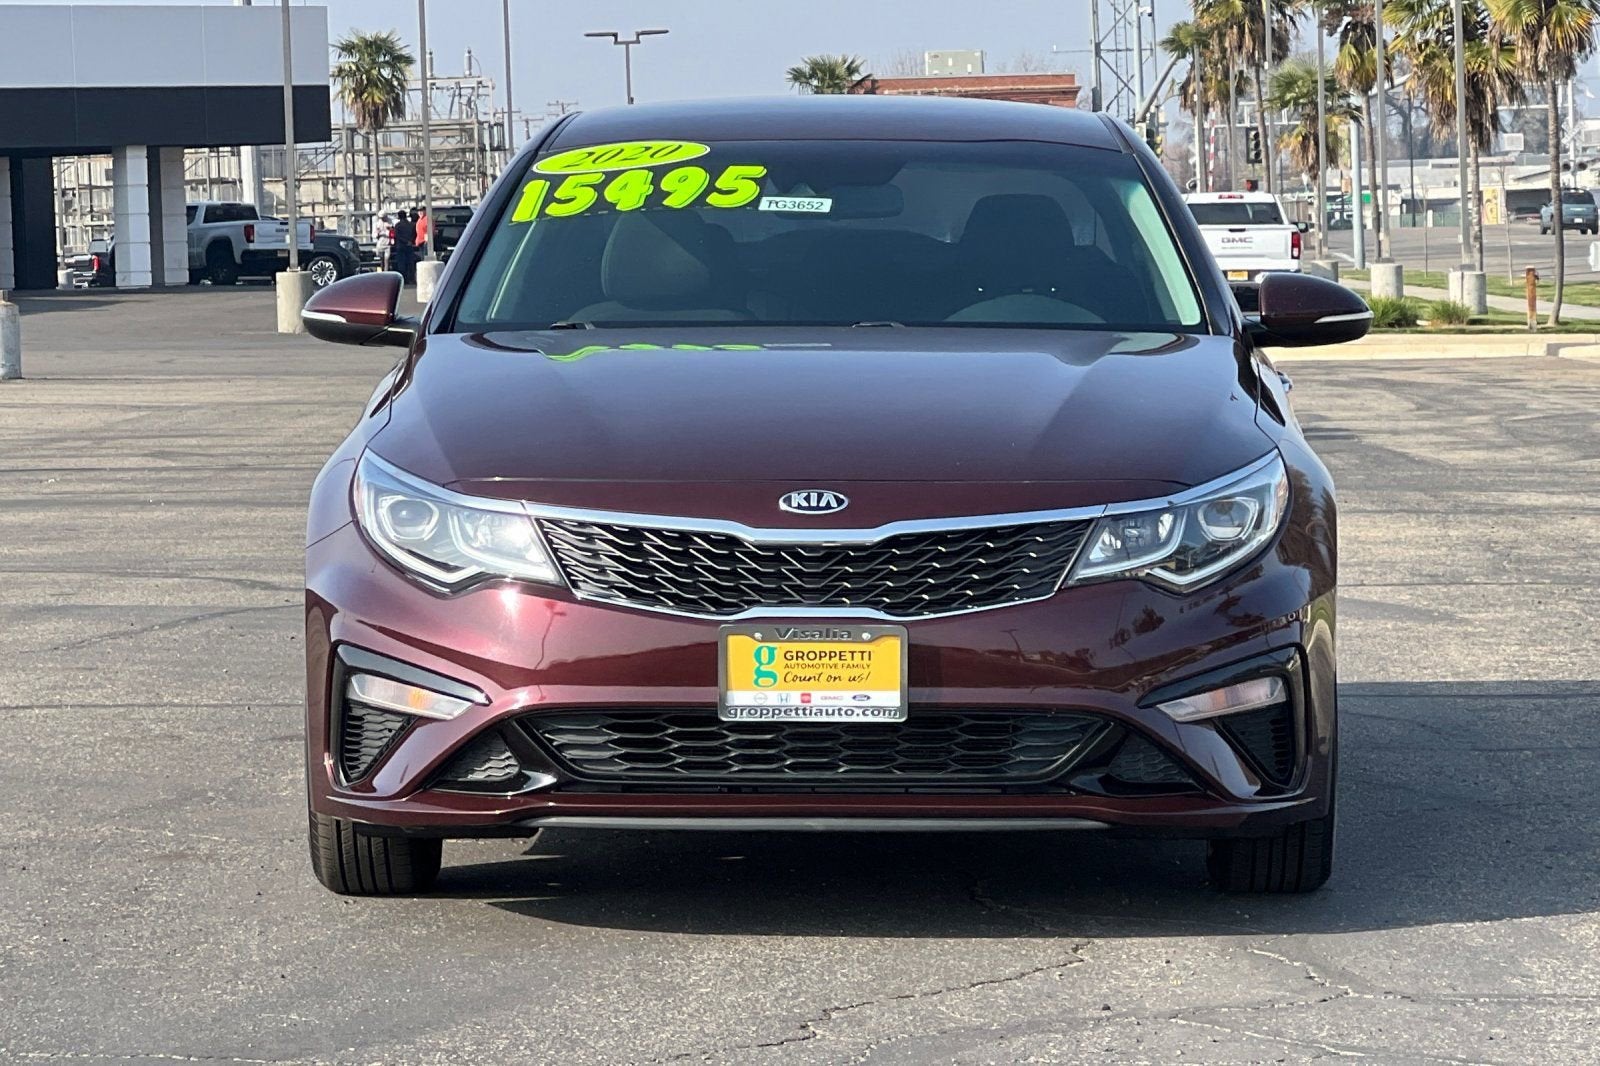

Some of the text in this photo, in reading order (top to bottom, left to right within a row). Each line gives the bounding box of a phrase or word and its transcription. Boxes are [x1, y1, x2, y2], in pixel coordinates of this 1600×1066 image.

[564, 144, 684, 168] 2020
[511, 165, 767, 222] 15495
[766, 199, 824, 210] TG3652
[791, 492, 838, 507] KIA
[774, 627, 853, 640] Visalia
[783, 650, 872, 661] GROPPETTI
[783, 671, 824, 683] Count
[826, 675, 842, 683] on
[727, 705, 900, 719] groppettiauto.com
